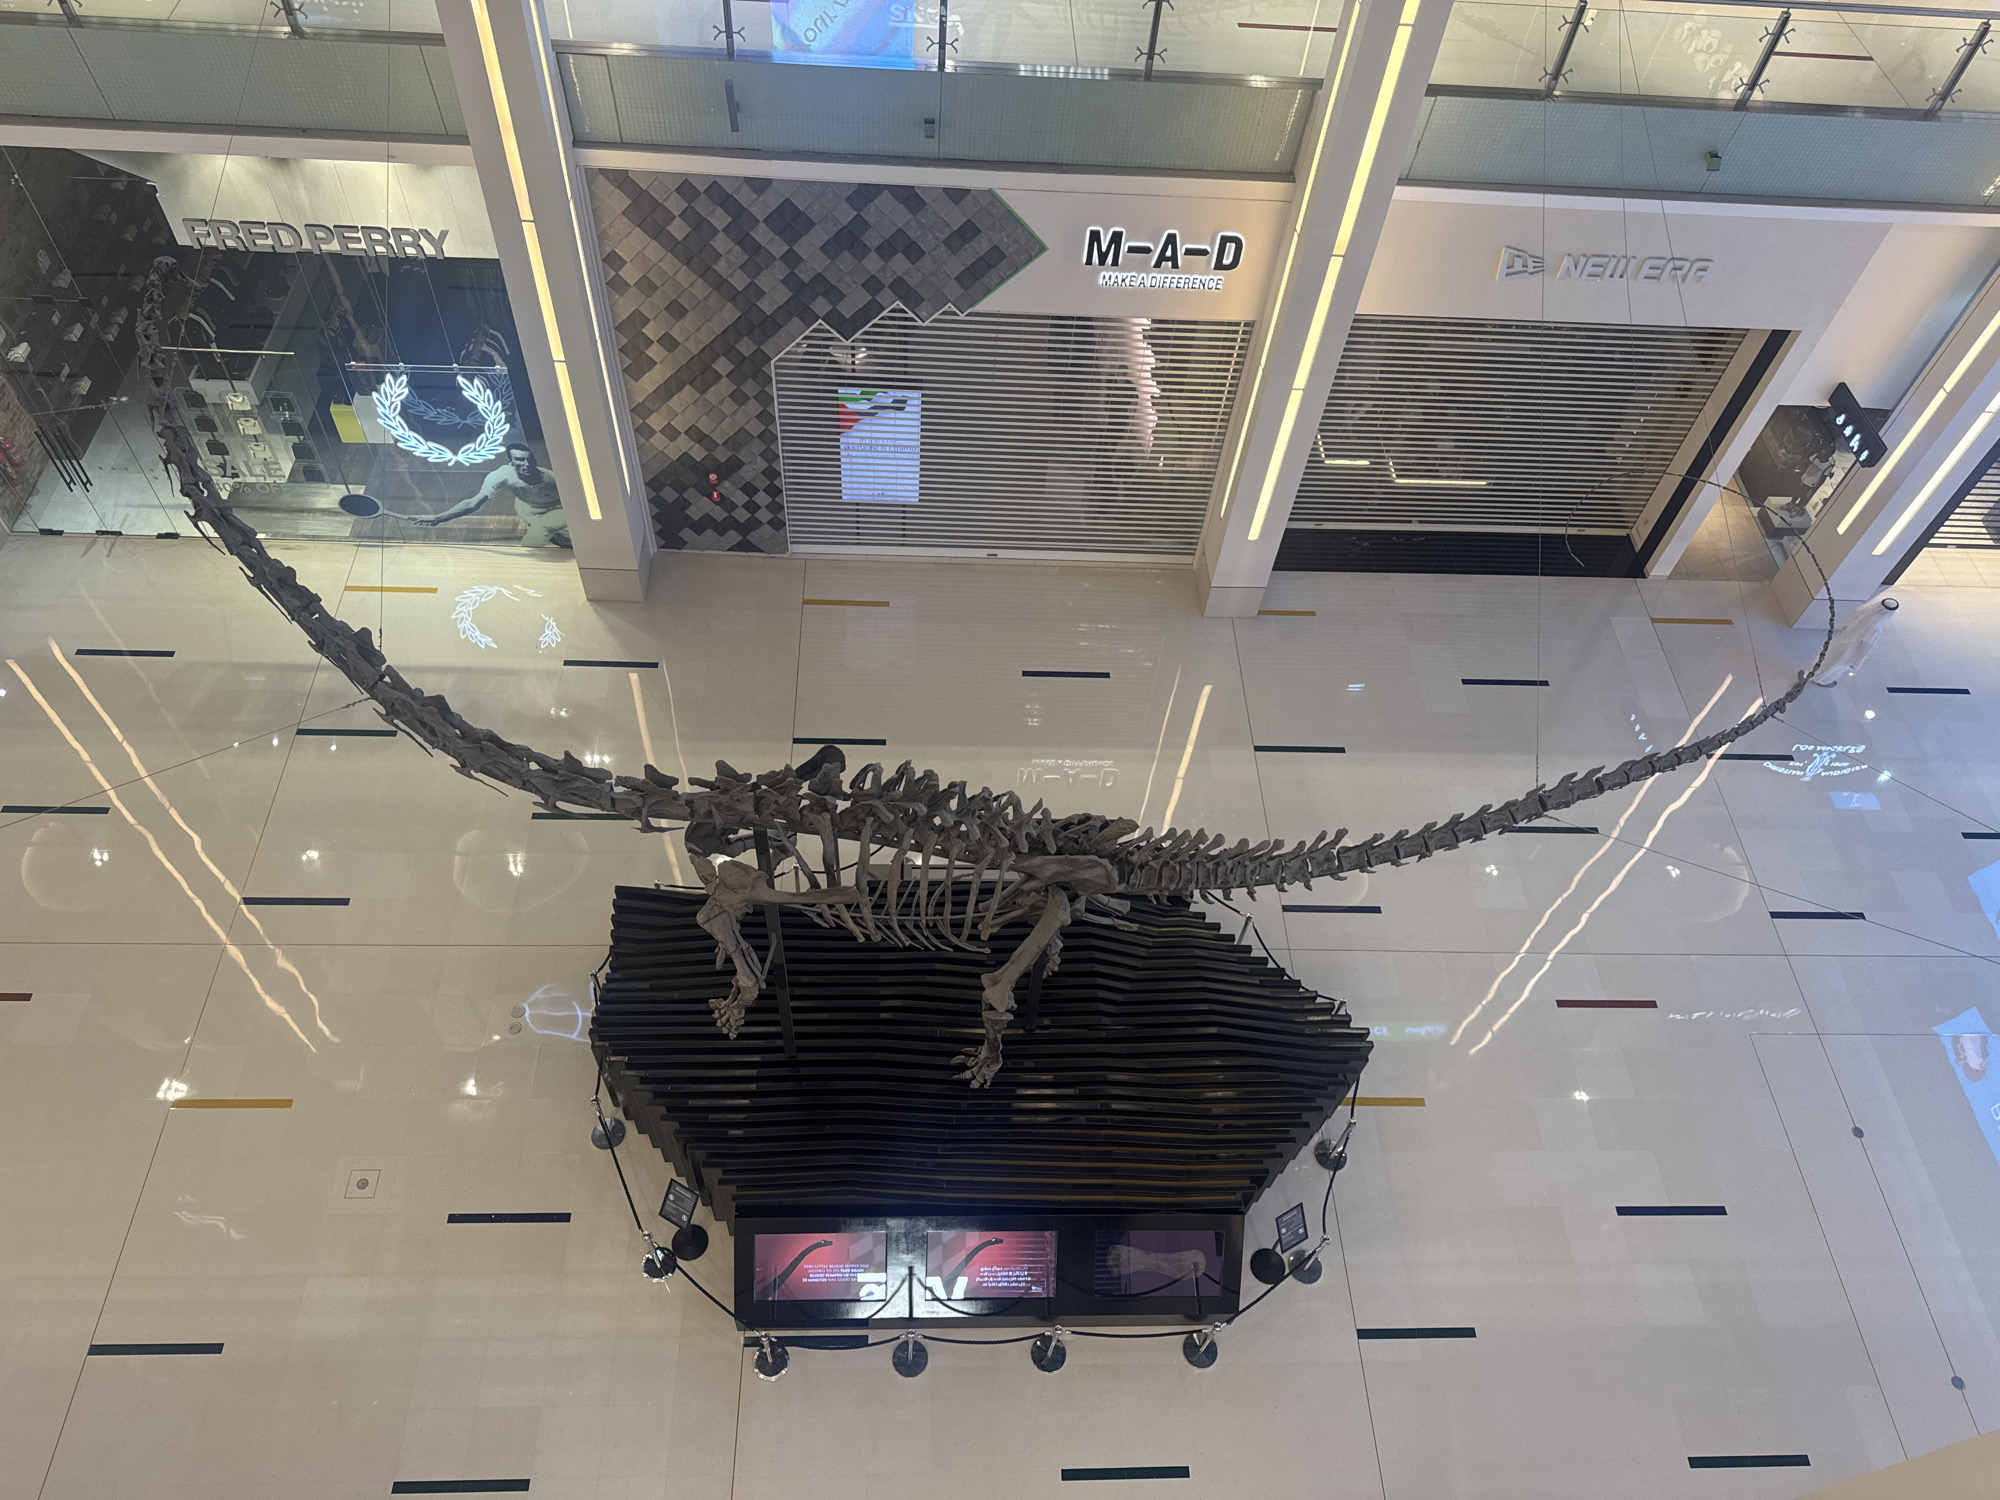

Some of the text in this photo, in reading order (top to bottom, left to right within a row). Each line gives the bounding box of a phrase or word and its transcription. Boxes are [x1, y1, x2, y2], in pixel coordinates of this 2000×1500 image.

[182, 218, 449, 260] FRED PERRY
[1084, 228, 1244, 271] M-A-D
[1556, 253, 1715, 284] NEW ERA
[1101, 274, 1223, 291] MAKE A DIFFERENCE
[202, 457, 286, 478] SALE
[256, 483, 291, 494] OFF
